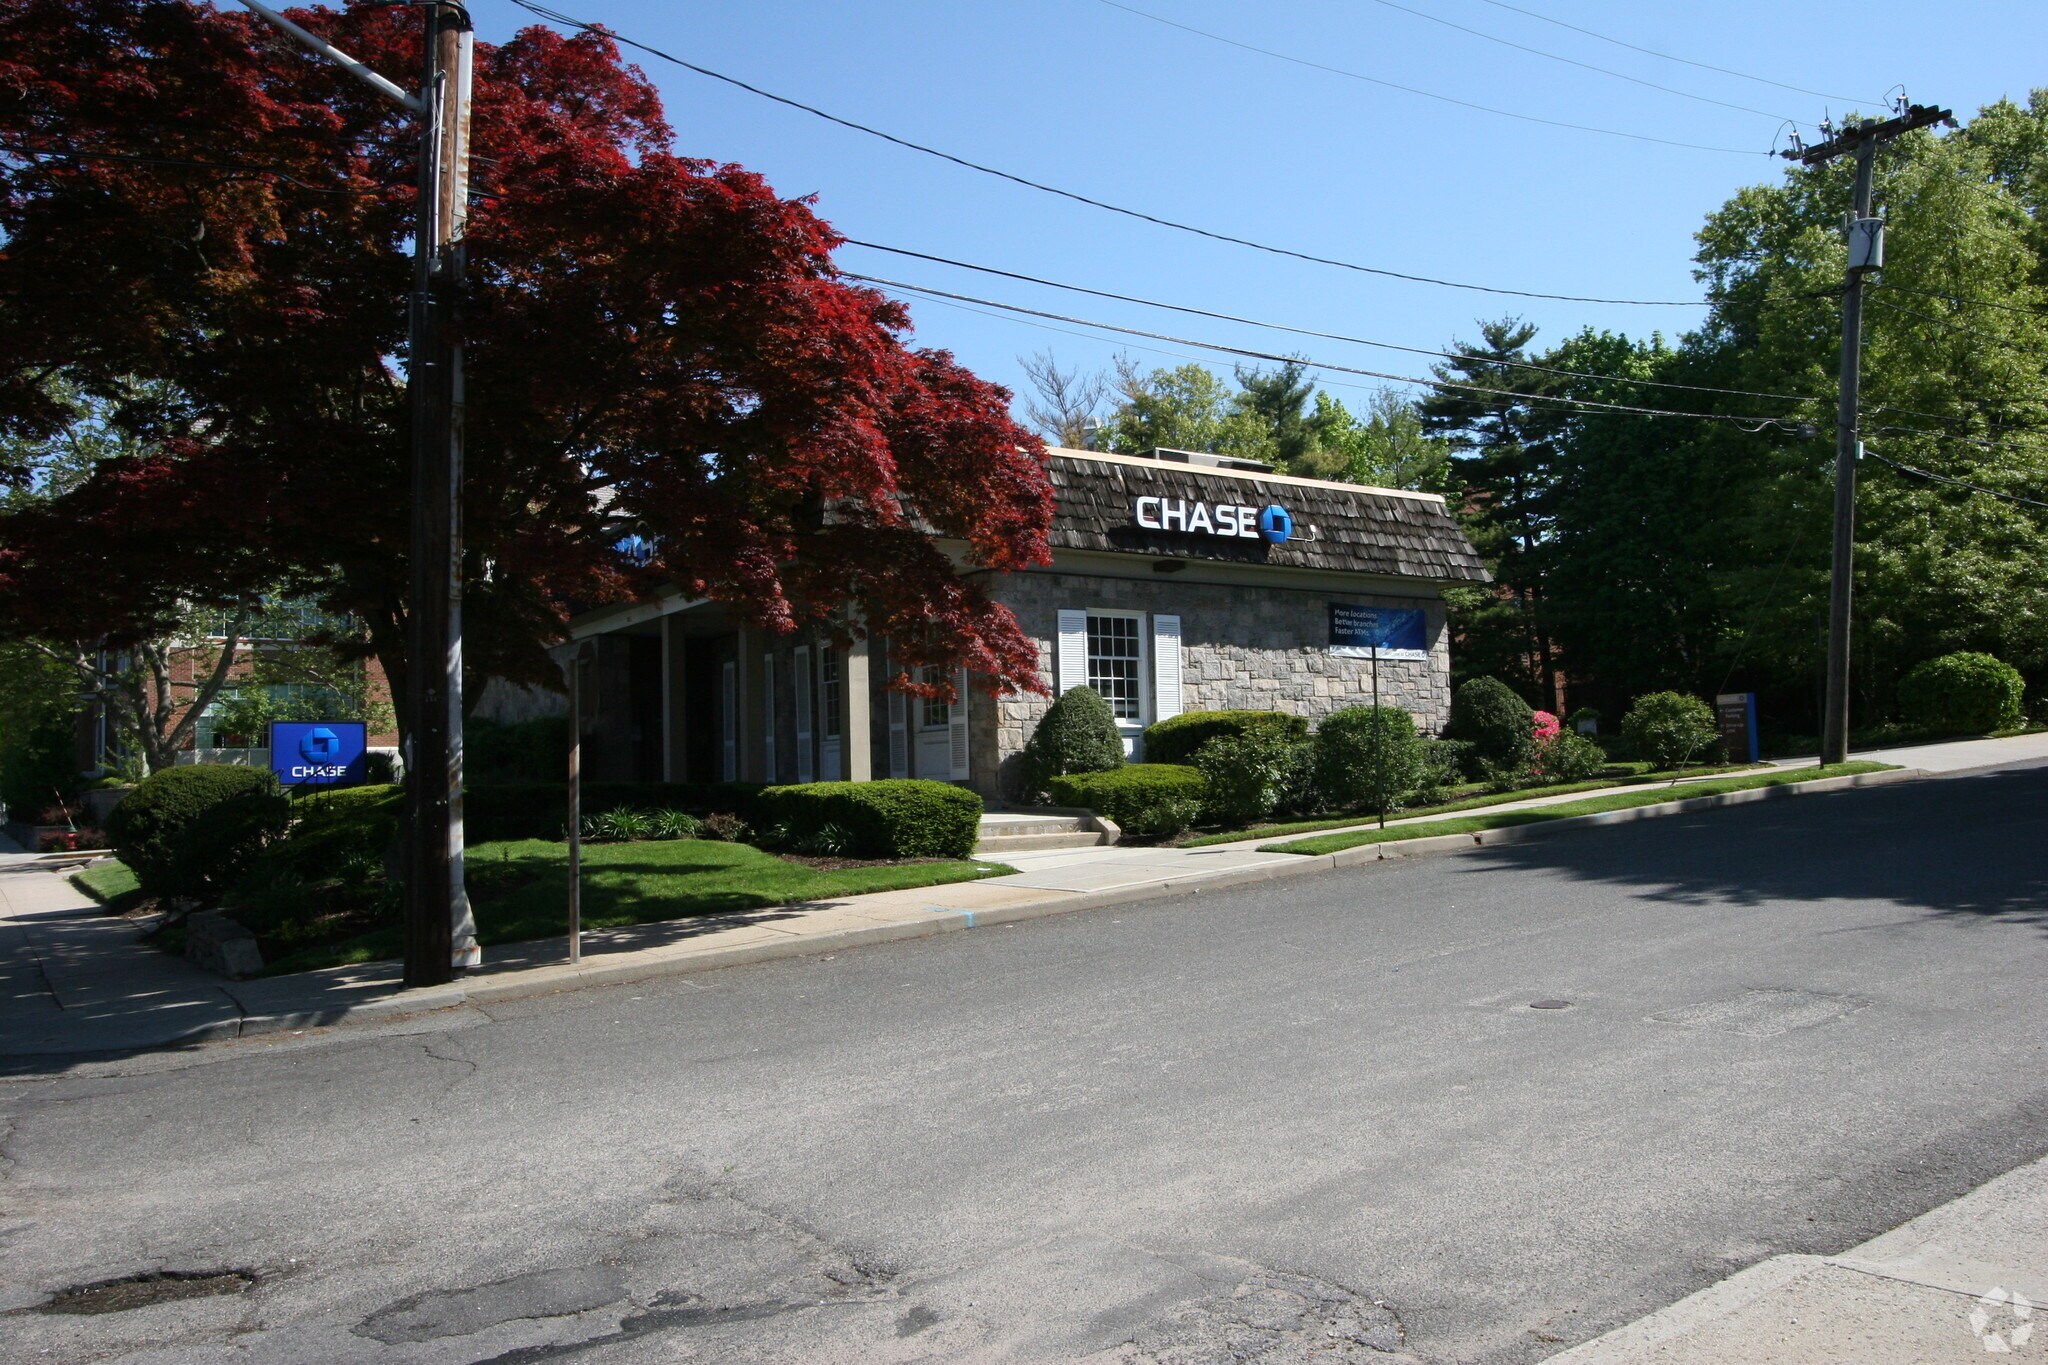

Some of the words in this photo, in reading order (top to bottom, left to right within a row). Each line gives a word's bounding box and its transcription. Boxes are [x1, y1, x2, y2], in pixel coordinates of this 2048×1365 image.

[1136, 496, 1260, 539] CHASE
[1334, 609, 1350, 618] More
[1334, 627, 1354, 635] Faster
[291, 765, 347, 778] CHASE
